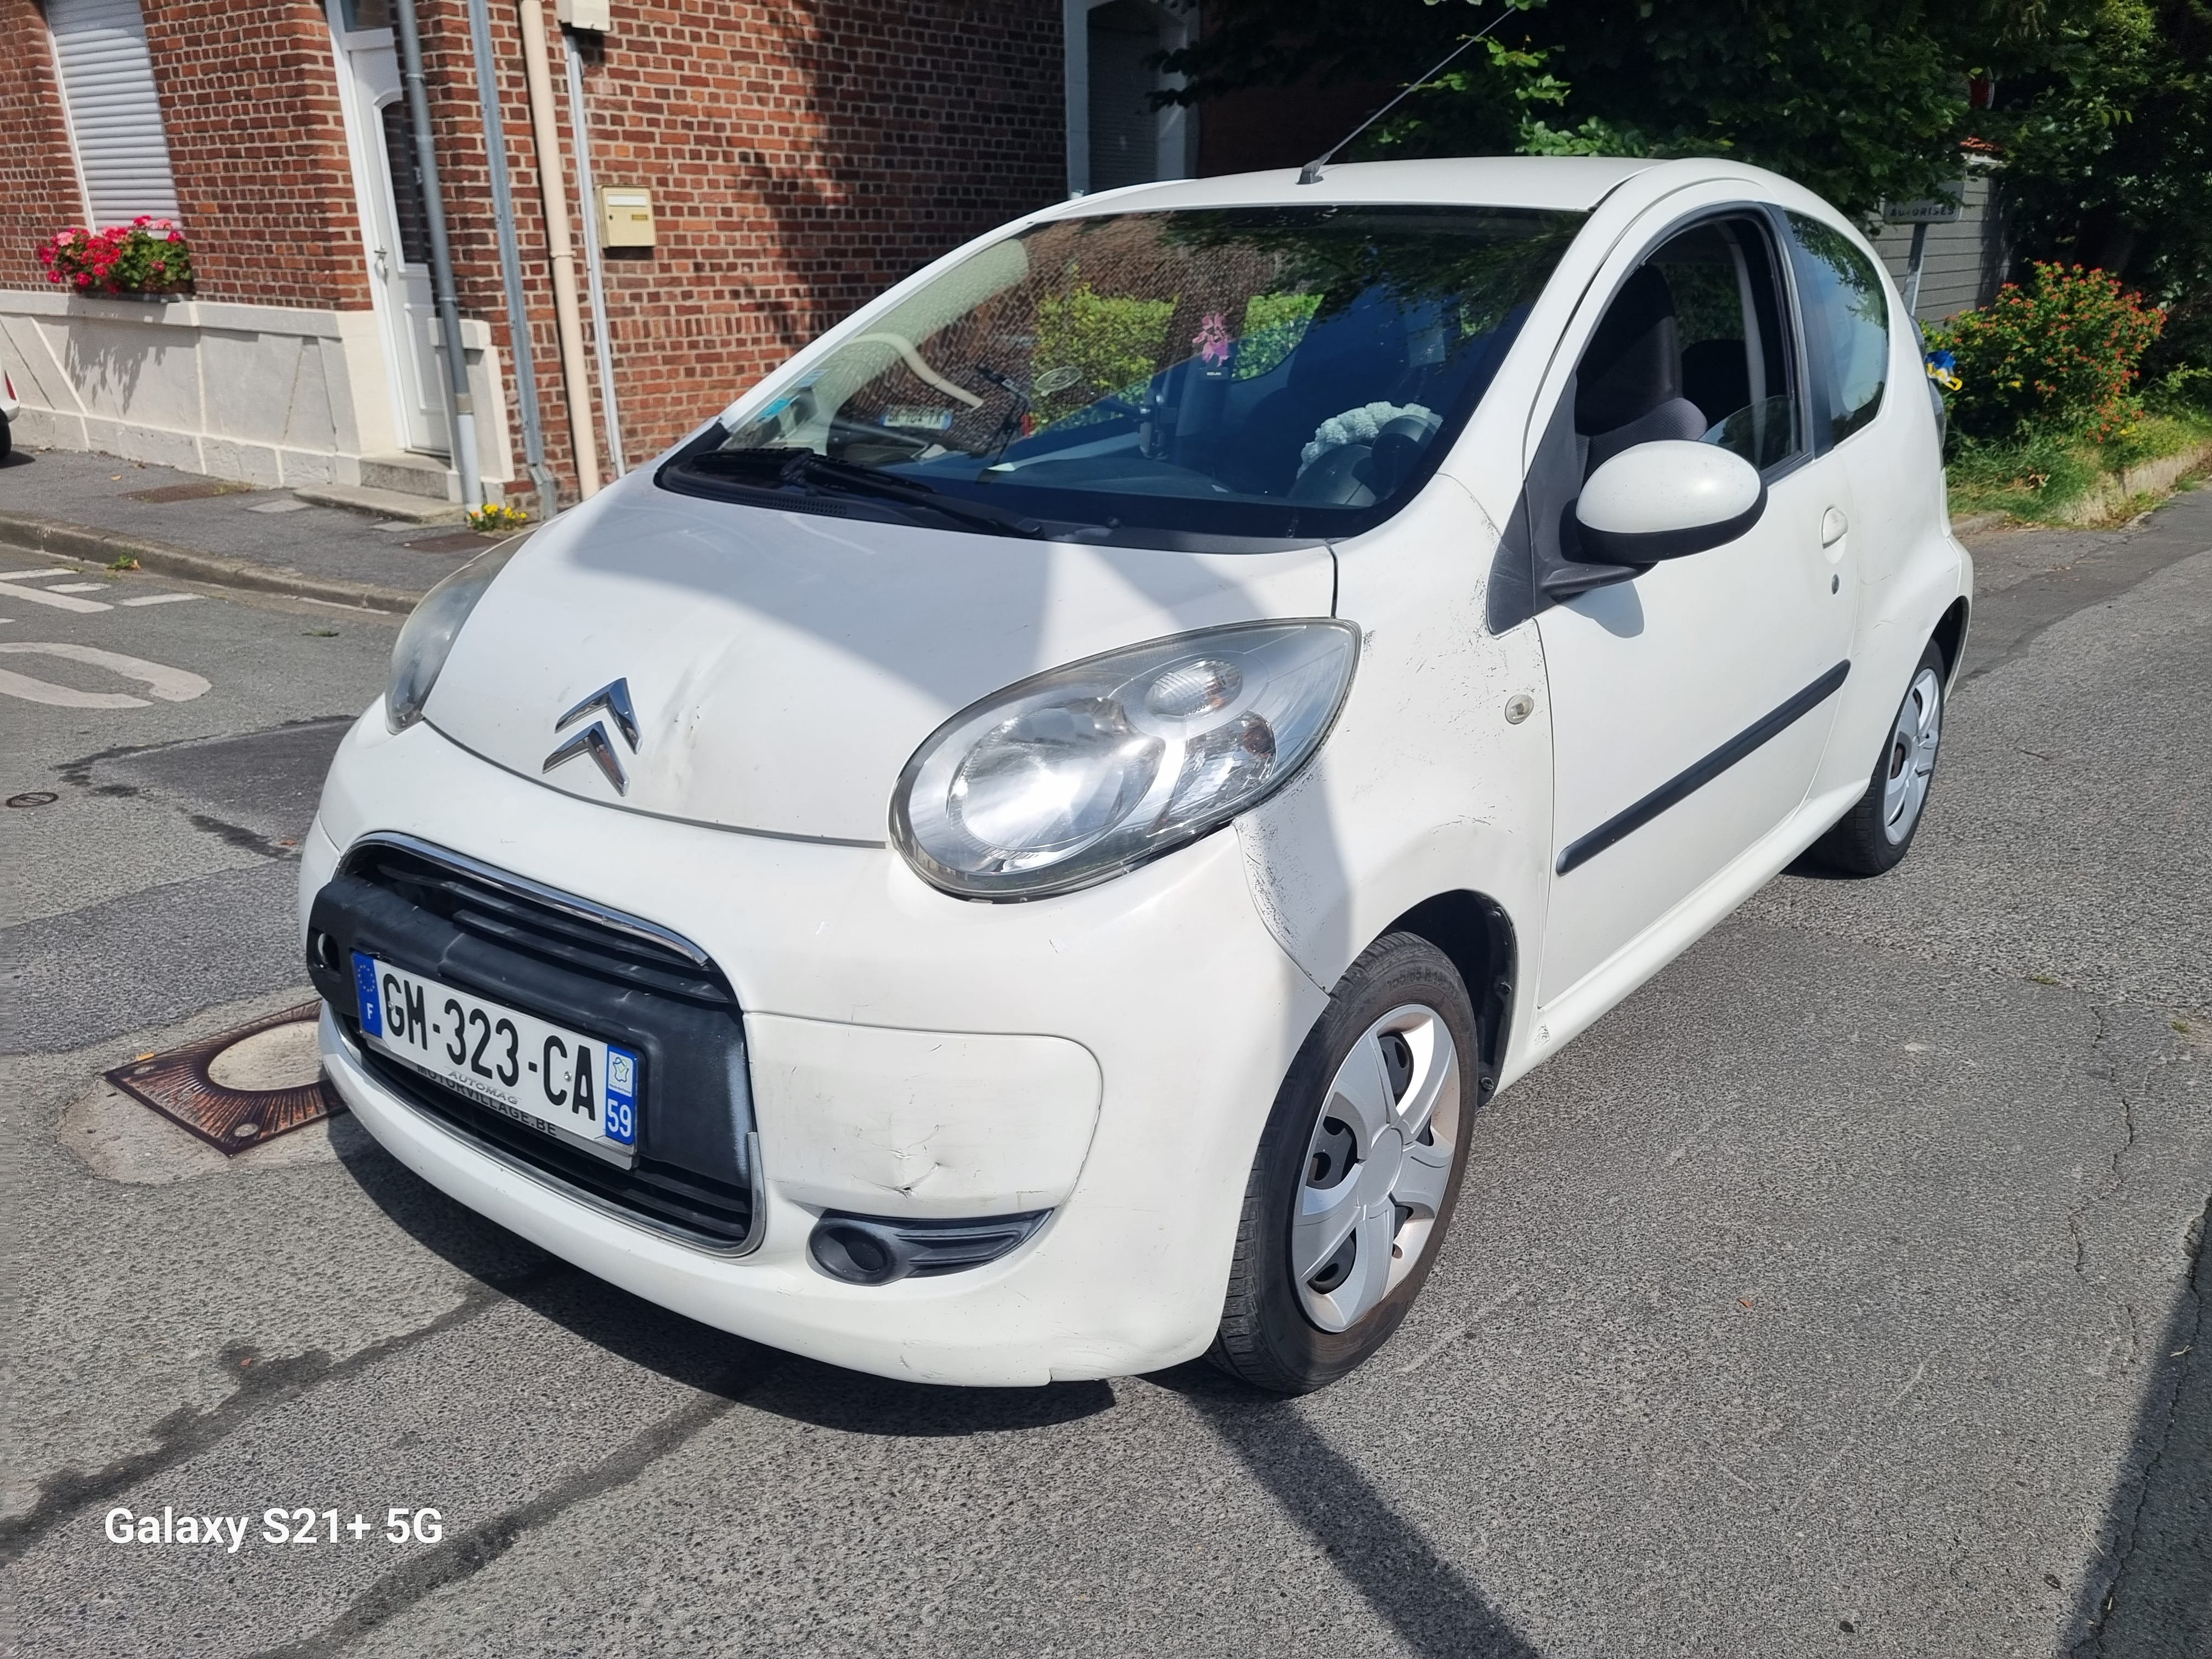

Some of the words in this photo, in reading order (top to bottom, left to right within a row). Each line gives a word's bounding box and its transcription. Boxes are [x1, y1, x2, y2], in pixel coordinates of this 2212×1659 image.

[366, 1002, 373, 1020] F
[382, 973, 596, 1122] GM-323-CA
[448, 1070, 518, 1105] AUTOMAG
[607, 1099, 632, 1138] 59
